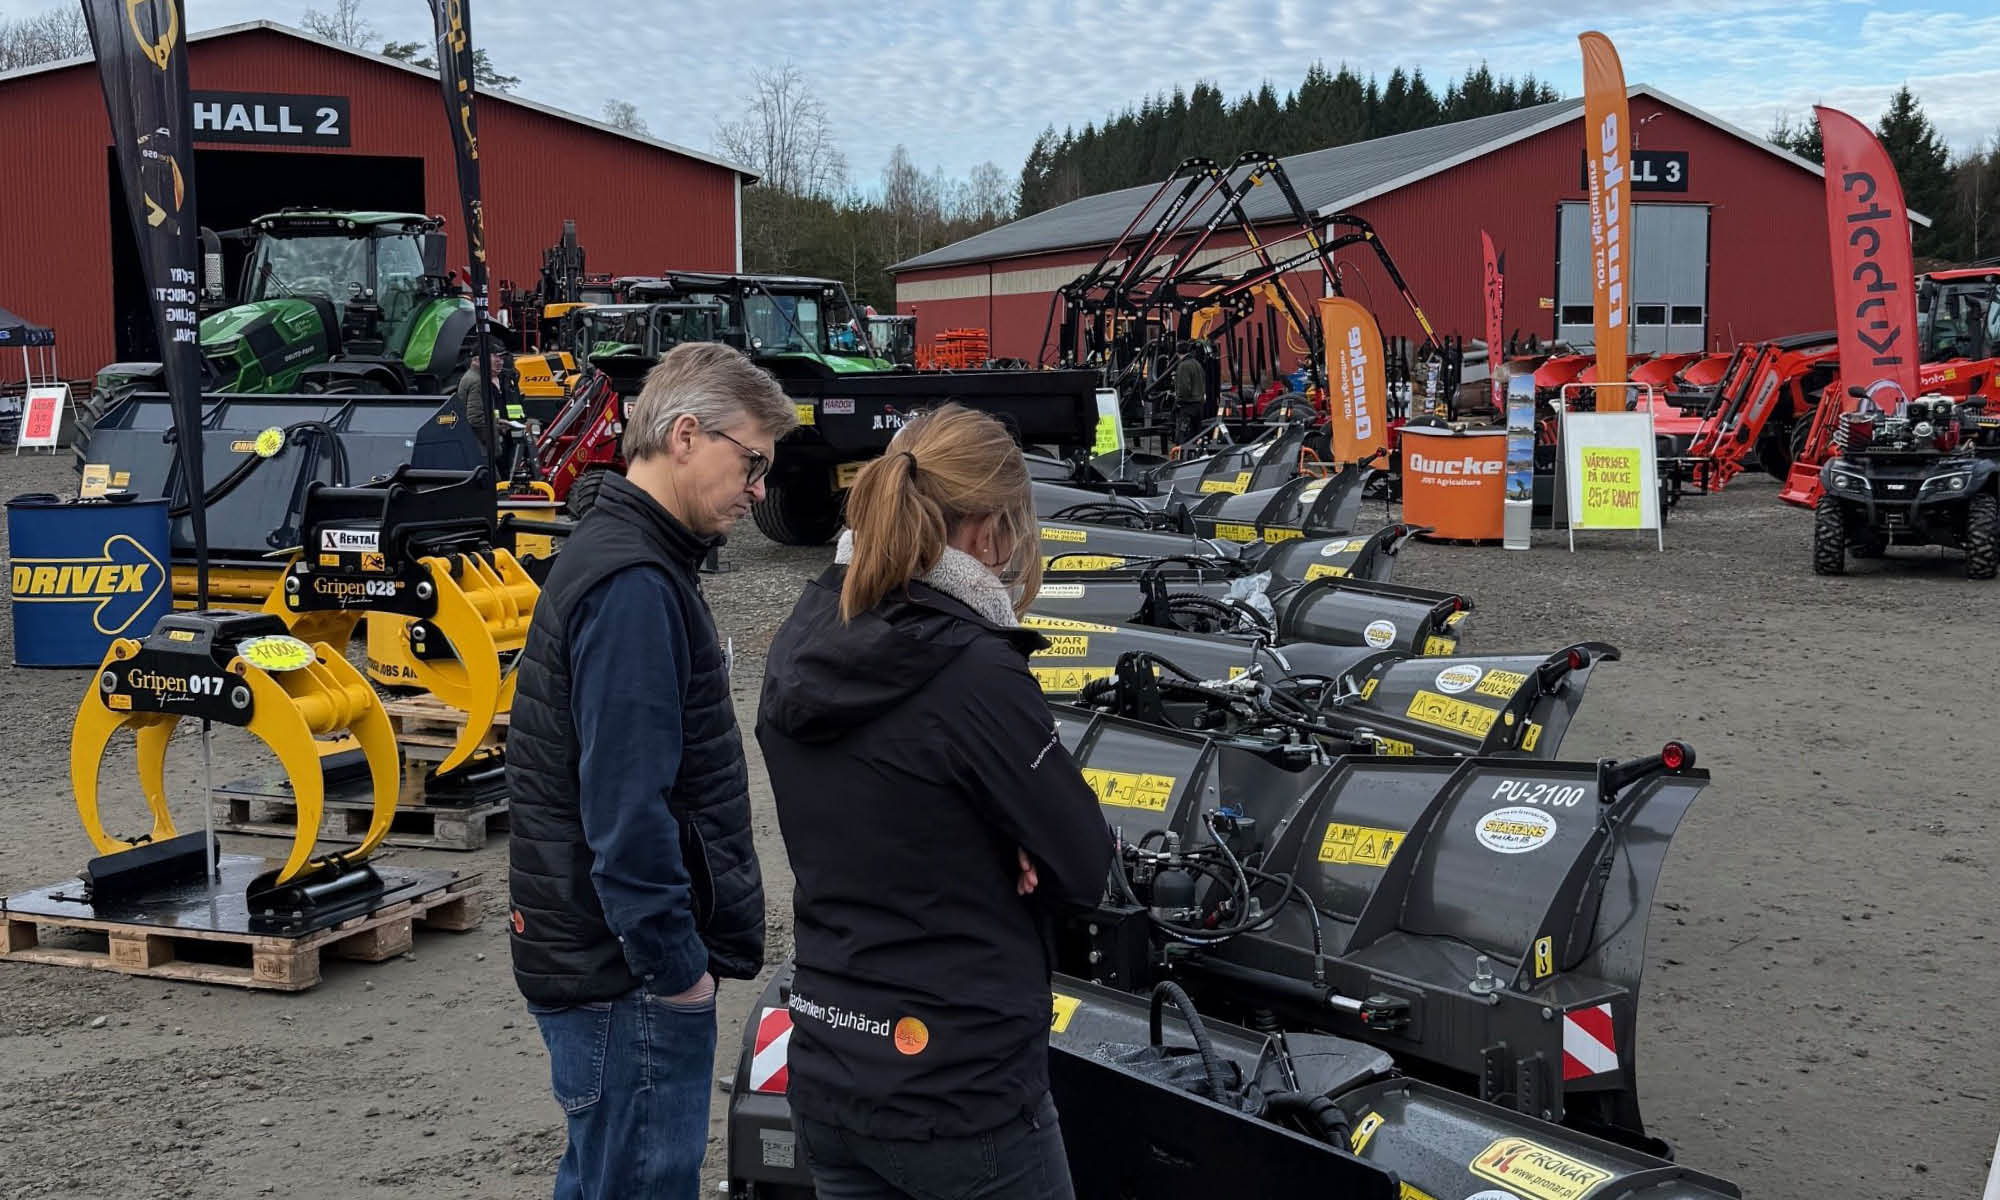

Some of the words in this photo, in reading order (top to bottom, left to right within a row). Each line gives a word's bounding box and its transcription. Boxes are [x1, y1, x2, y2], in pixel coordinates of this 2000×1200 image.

[194, 103, 303, 134] HALL
[315, 107, 339, 135] 2
[1630, 160, 1658, 182] LL
[1665, 161, 1681, 182] 3
[1921, 373, 1945, 385] bota
[1410, 453, 1503, 475] Quicke
[340, 533, 376, 545] RENTAL
[12, 563, 149, 594] DRIVEX
[314, 577, 366, 598] Gripen
[366, 580, 396, 596] 028
[1053, 637, 1082, 645] NAR
[128, 668, 188, 696] Gripen
[189, 675, 224, 696] 017
[1479, 681, 1516, 697] PUV-240
[1490, 671, 1524, 685] PRONA
[1491, 780, 1585, 807] PU-2100
[1483, 820, 1549, 838] STAFFANS
[789, 989, 826, 1020] arbanken
[826, 1005, 890, 1037] Sjuhärad
[1522, 1151, 1597, 1185] PRONAR
[1511, 1166, 1579, 1199] www.pronar.pl
